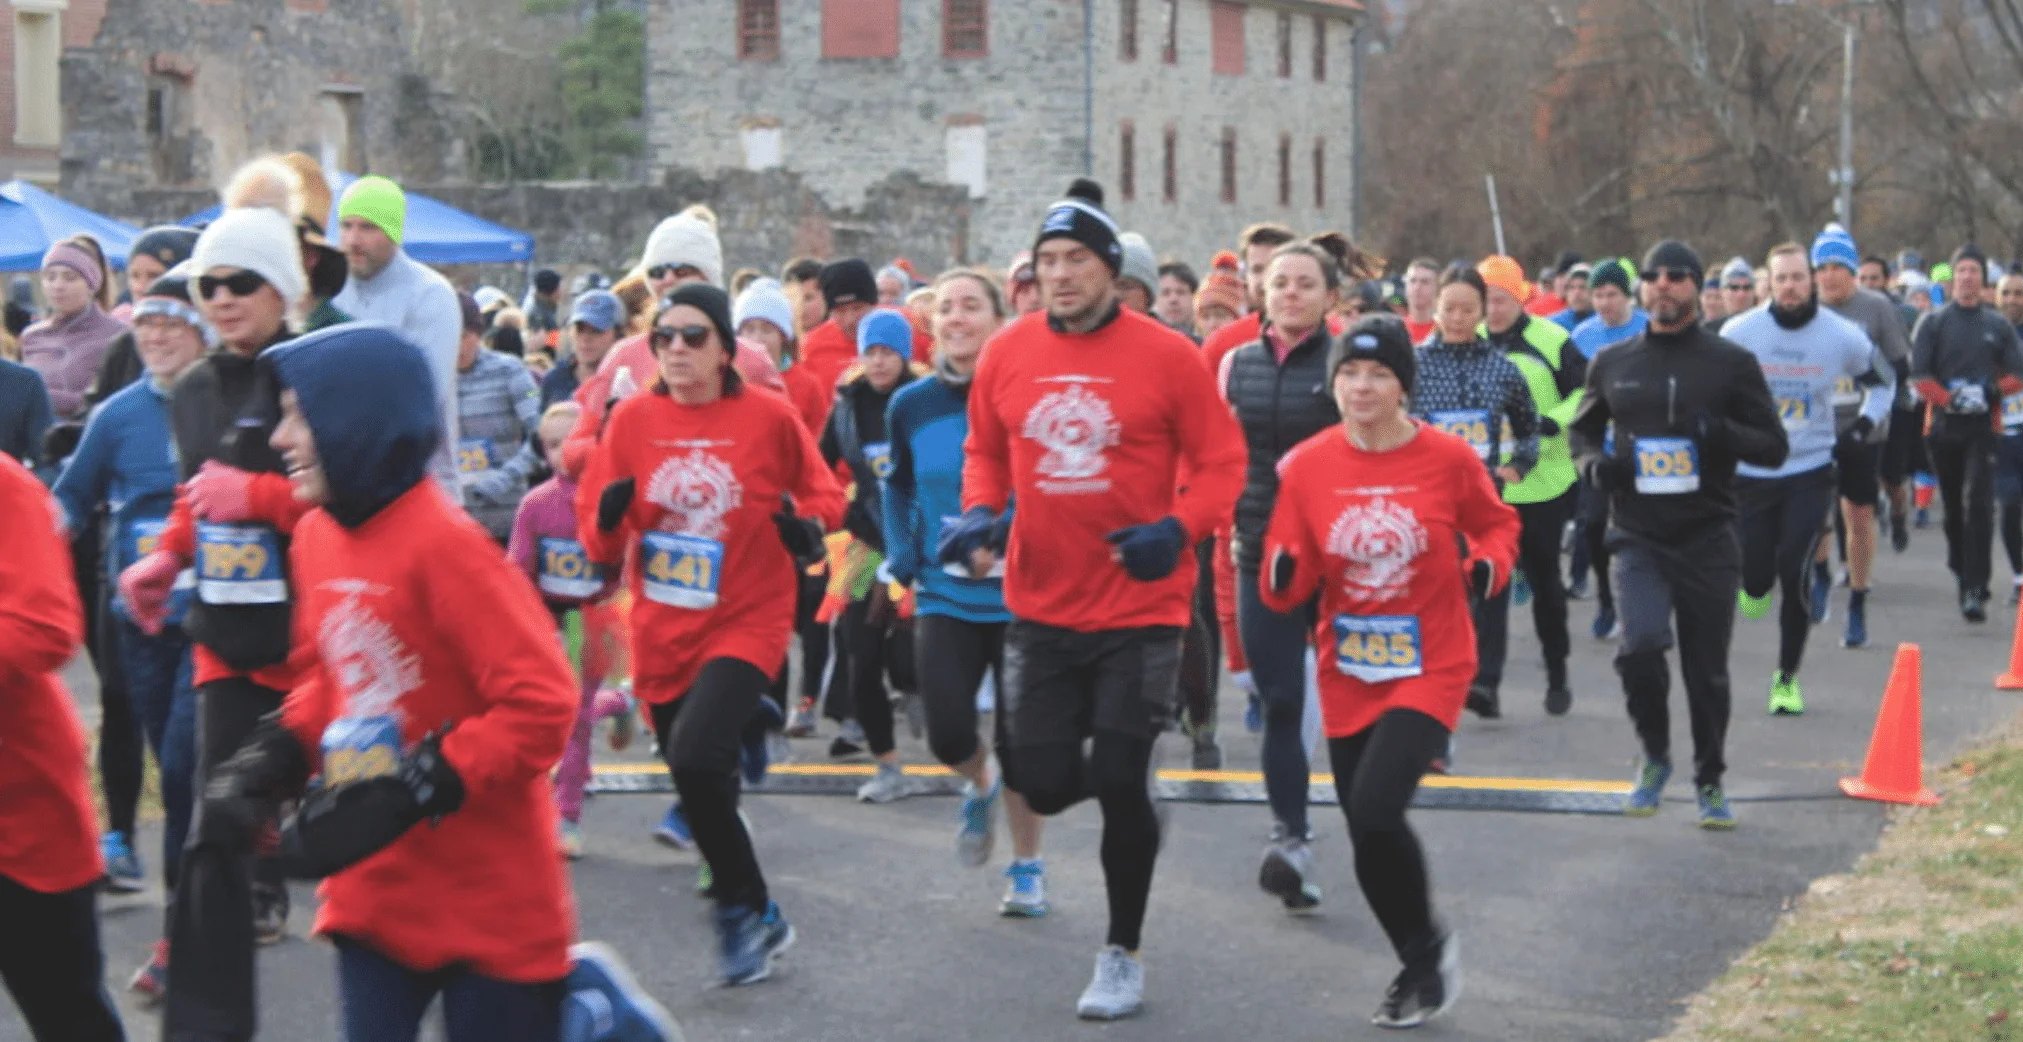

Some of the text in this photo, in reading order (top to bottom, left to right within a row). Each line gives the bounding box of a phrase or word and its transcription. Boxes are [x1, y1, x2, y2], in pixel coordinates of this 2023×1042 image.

[1639, 450, 1693, 476] 105
[648, 551, 711, 588] 441
[1339, 632, 1416, 665] 485
